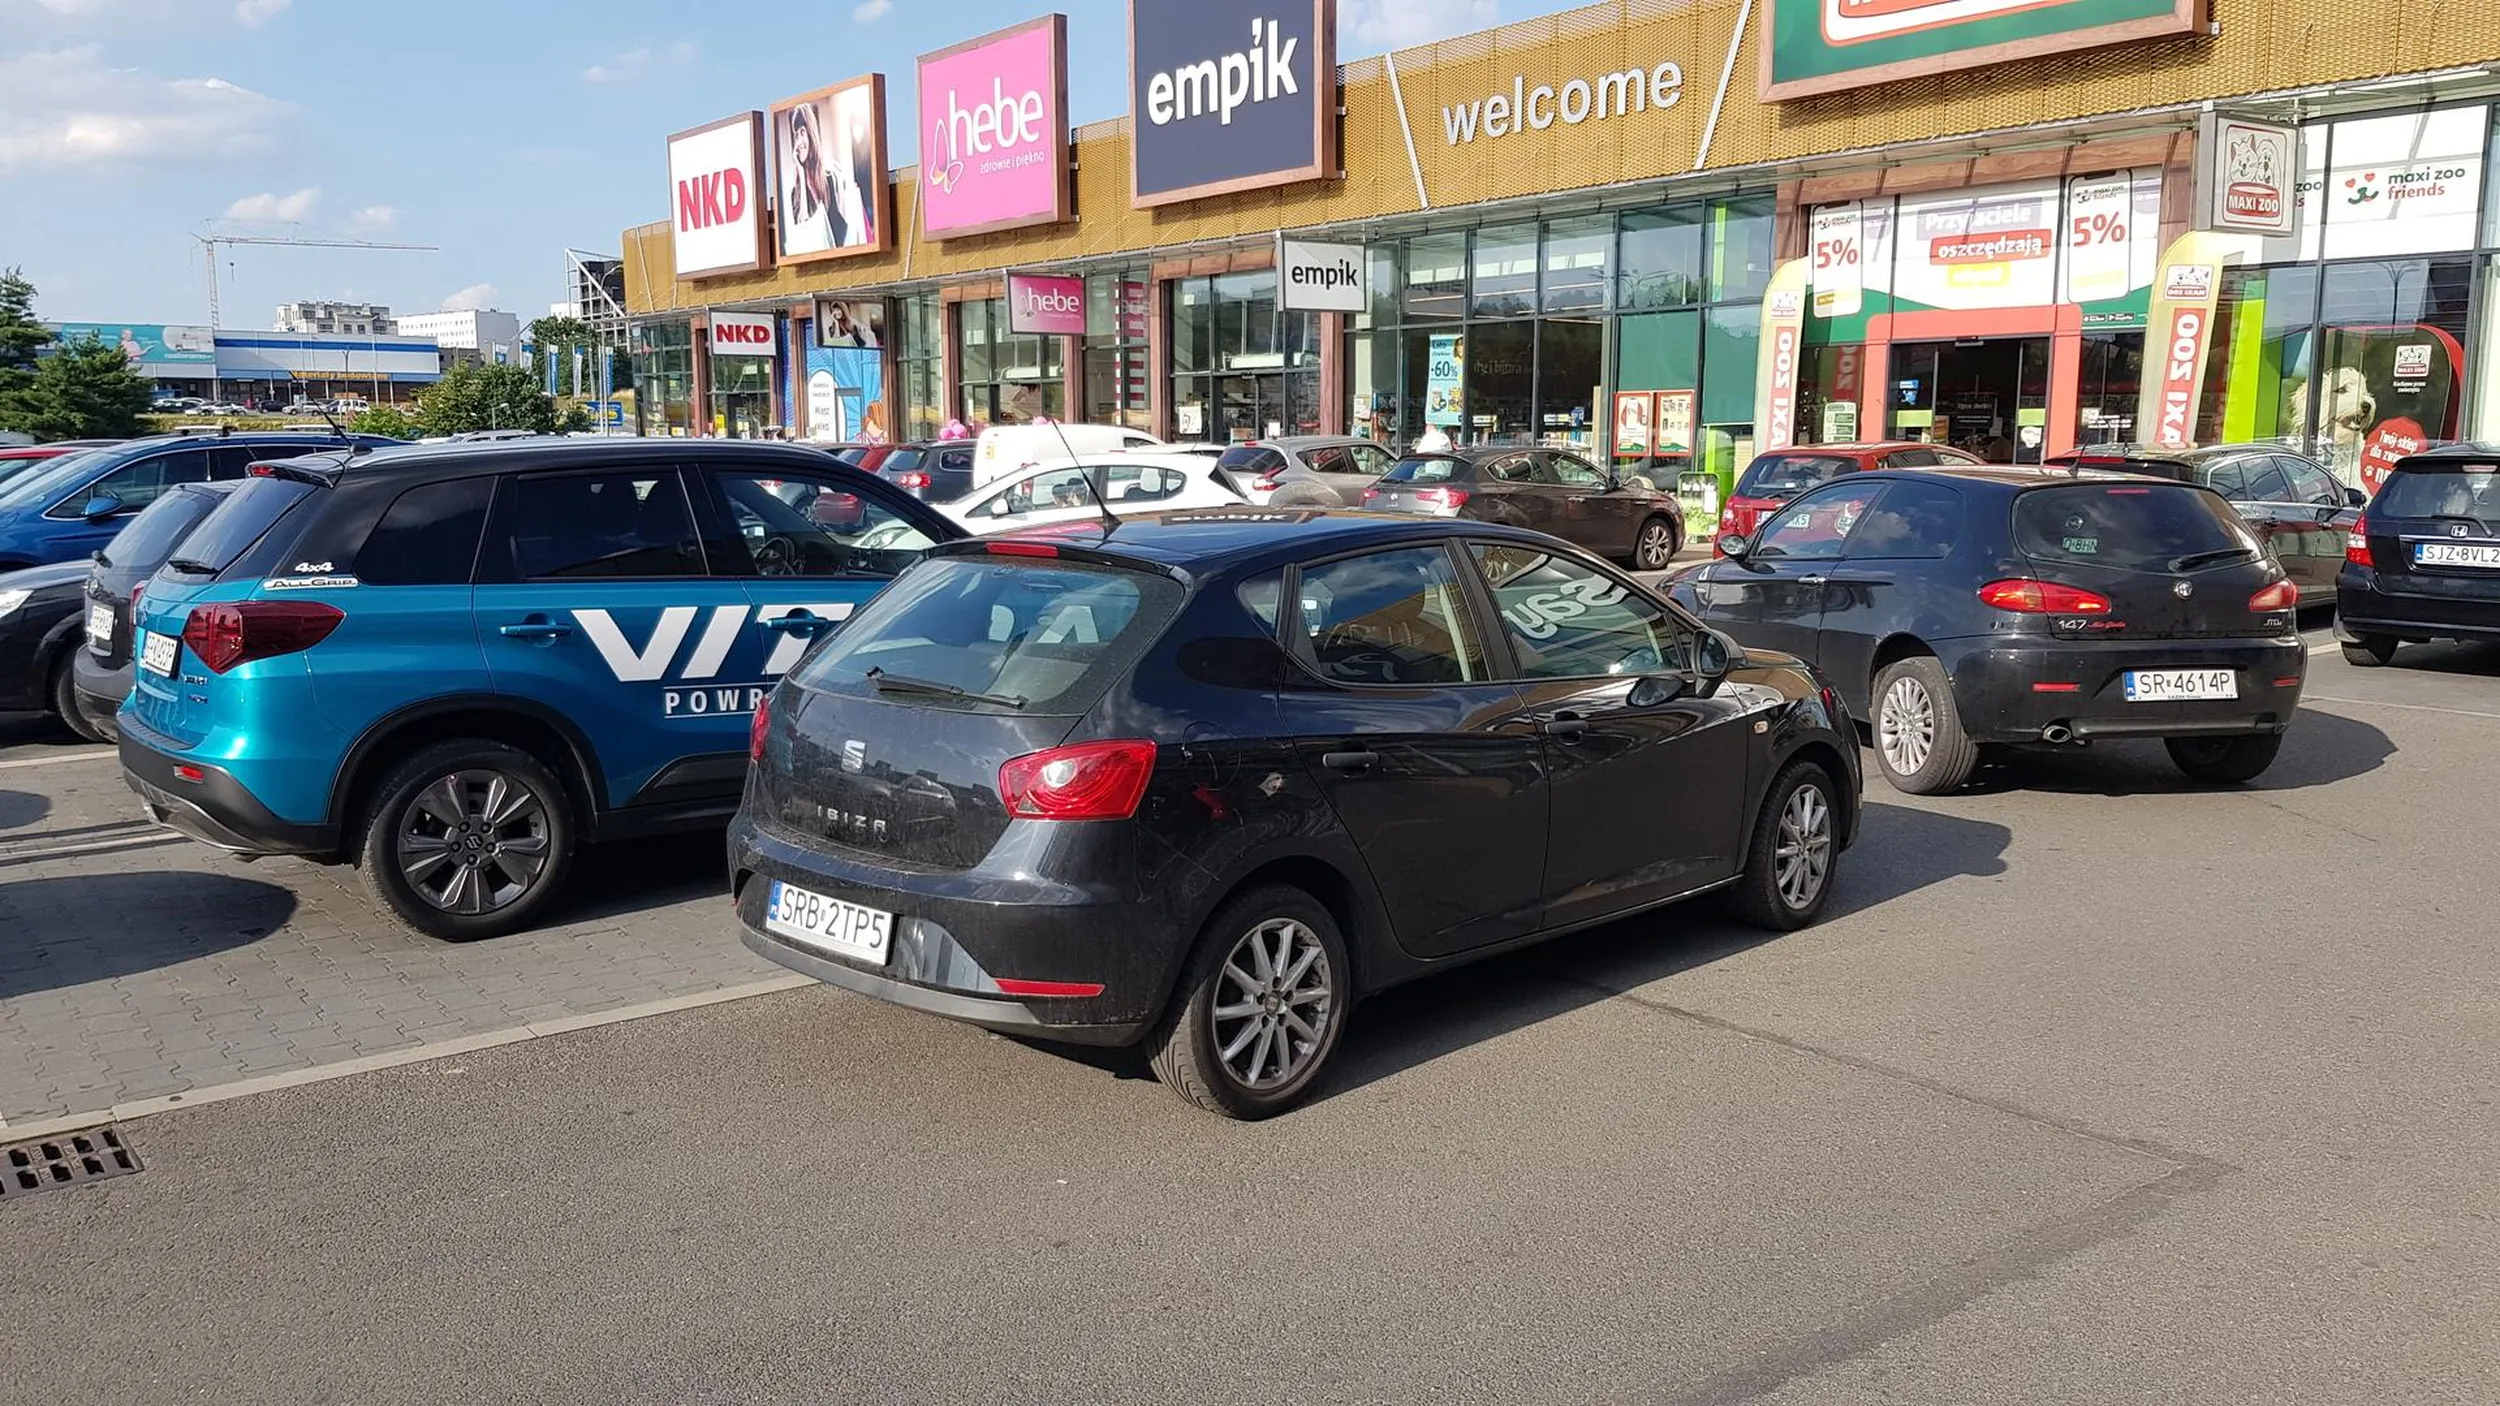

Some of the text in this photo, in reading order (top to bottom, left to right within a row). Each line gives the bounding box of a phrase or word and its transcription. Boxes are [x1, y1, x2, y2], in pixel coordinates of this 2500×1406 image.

[1147, 18, 1299, 125] empik
[1443, 61, 1683, 146] welcome
[949, 77, 1044, 160] hebe
[2388, 166, 2465, 185] maxi zoo
[679, 167, 745, 232] NKD
[2228, 195, 2279, 212] MAXI ZOO
[2388, 182, 2445, 201] friends
[1925, 203, 2031, 235] Przyjaciele
[2074, 211, 2126, 247] 5%
[1817, 237, 1858, 269] 5%
[1938, 233, 2043, 259] oszczędzają
[1291, 259, 1358, 290] empik
[1028, 286, 1080, 313] hebe
[716, 324, 771, 344] NKD
[295, 562, 334, 573] 4x4
[2426, 546, 2500, 563] SJZ 8VL2
[2058, 619, 2087, 630] 147
[2139, 672, 2230, 694] SR 4614P
[817, 805, 887, 833] IBIZA
[781, 888, 886, 948] SRB 2TP5
